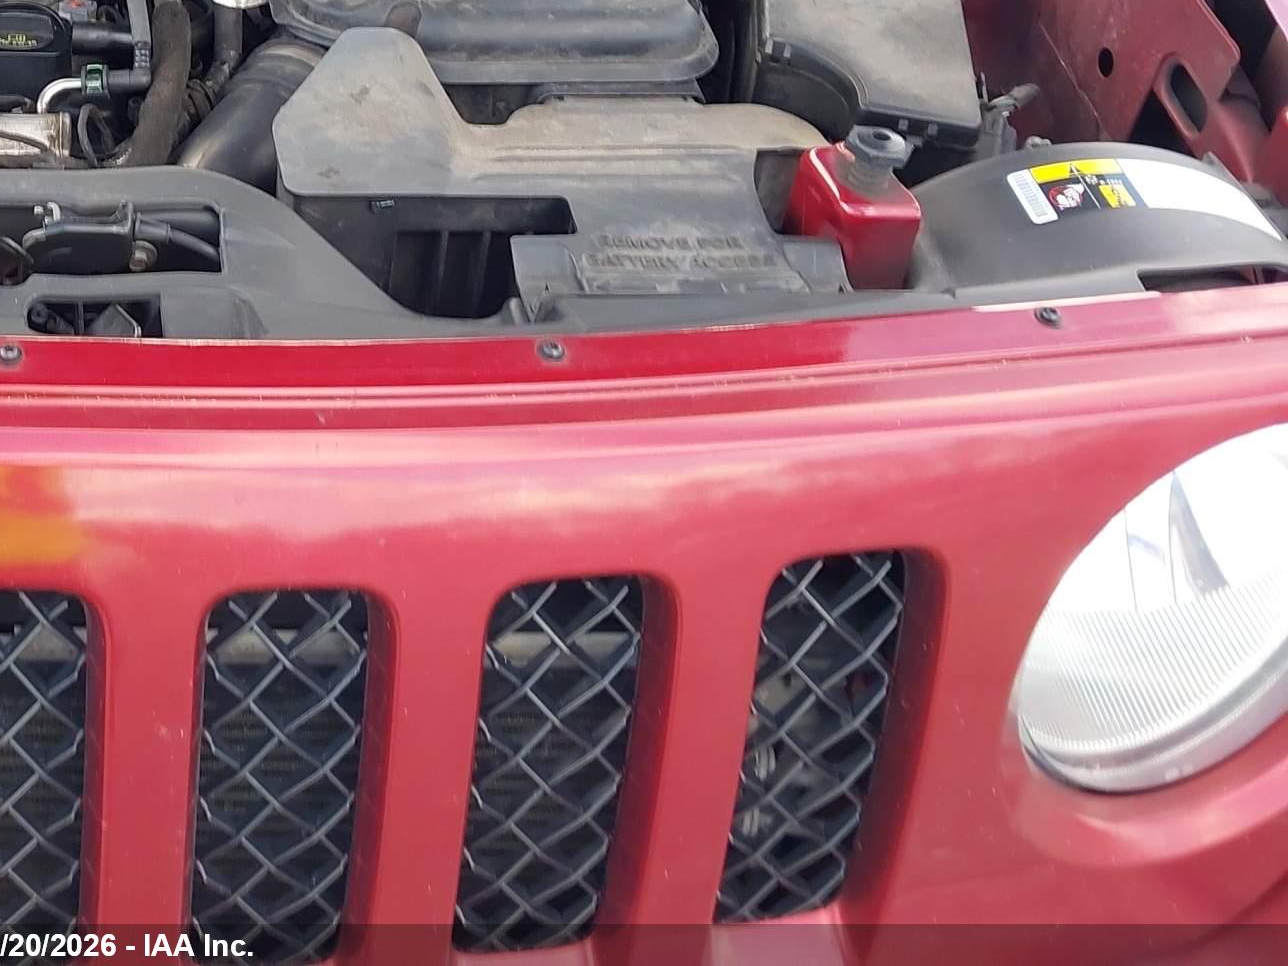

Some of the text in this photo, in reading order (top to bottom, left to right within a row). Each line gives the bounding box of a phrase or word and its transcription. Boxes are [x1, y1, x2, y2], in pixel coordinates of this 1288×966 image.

[596, 234, 744, 251] REMOVE FOR
[583, 252, 683, 269] BATTERY
